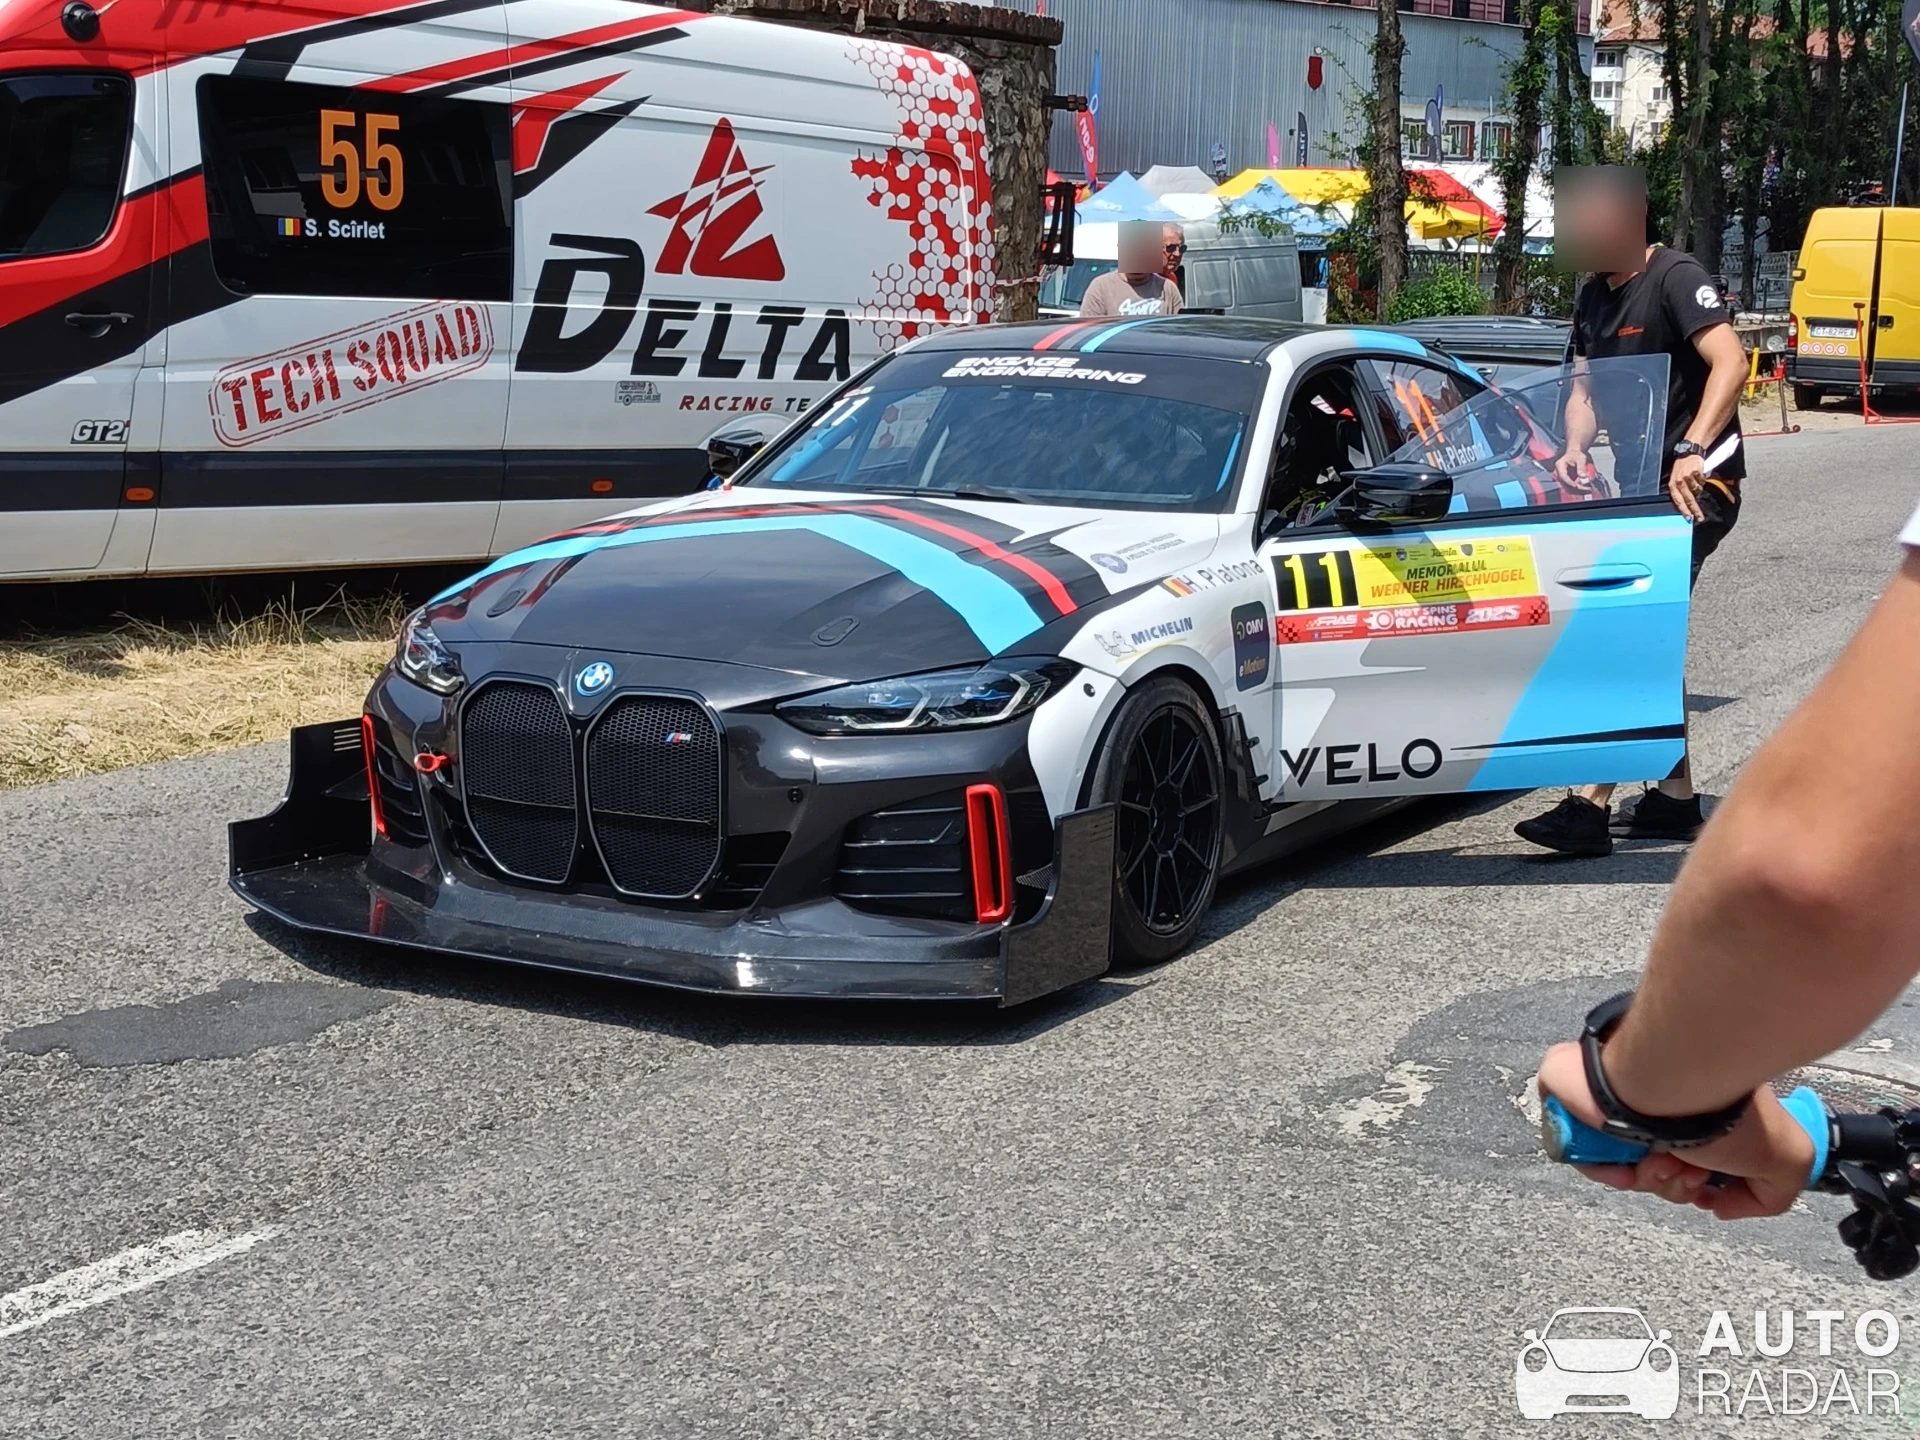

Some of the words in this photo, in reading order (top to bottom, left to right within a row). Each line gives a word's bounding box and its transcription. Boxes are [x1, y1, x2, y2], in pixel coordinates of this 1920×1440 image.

[320, 109, 404, 211] 55
[305, 218, 323, 237] S.
[328, 219, 385, 239] Scîrlet
[515, 233, 851, 382] DELTA
[222, 349, 341, 431] TECH
[346, 305, 482, 391] SQUAD
[955, 356, 1080, 368] ENGAGE
[942, 366, 1147, 384] ENGINEERING
[679, 394, 774, 412] RACING
[812, 396, 870, 428] 11
[1197, 559, 1264, 587] Platona
[1284, 551, 1344, 609] 11
[1406, 560, 1487, 580] MEMORIALUL
[1371, 580, 1430, 598] WERNER
[1436, 568, 1525, 591] HIRSCHVOGEL
[1394, 606, 1420, 618] HOT
[1422, 604, 1457, 616] SPINS
[1395, 613, 1459, 629] RACING
[1465, 604, 1522, 624] 2025
[1131, 617, 1194, 646] MICHELIN
[1246, 618, 1264, 636] OMV
[1279, 738, 1443, 788] VELO
